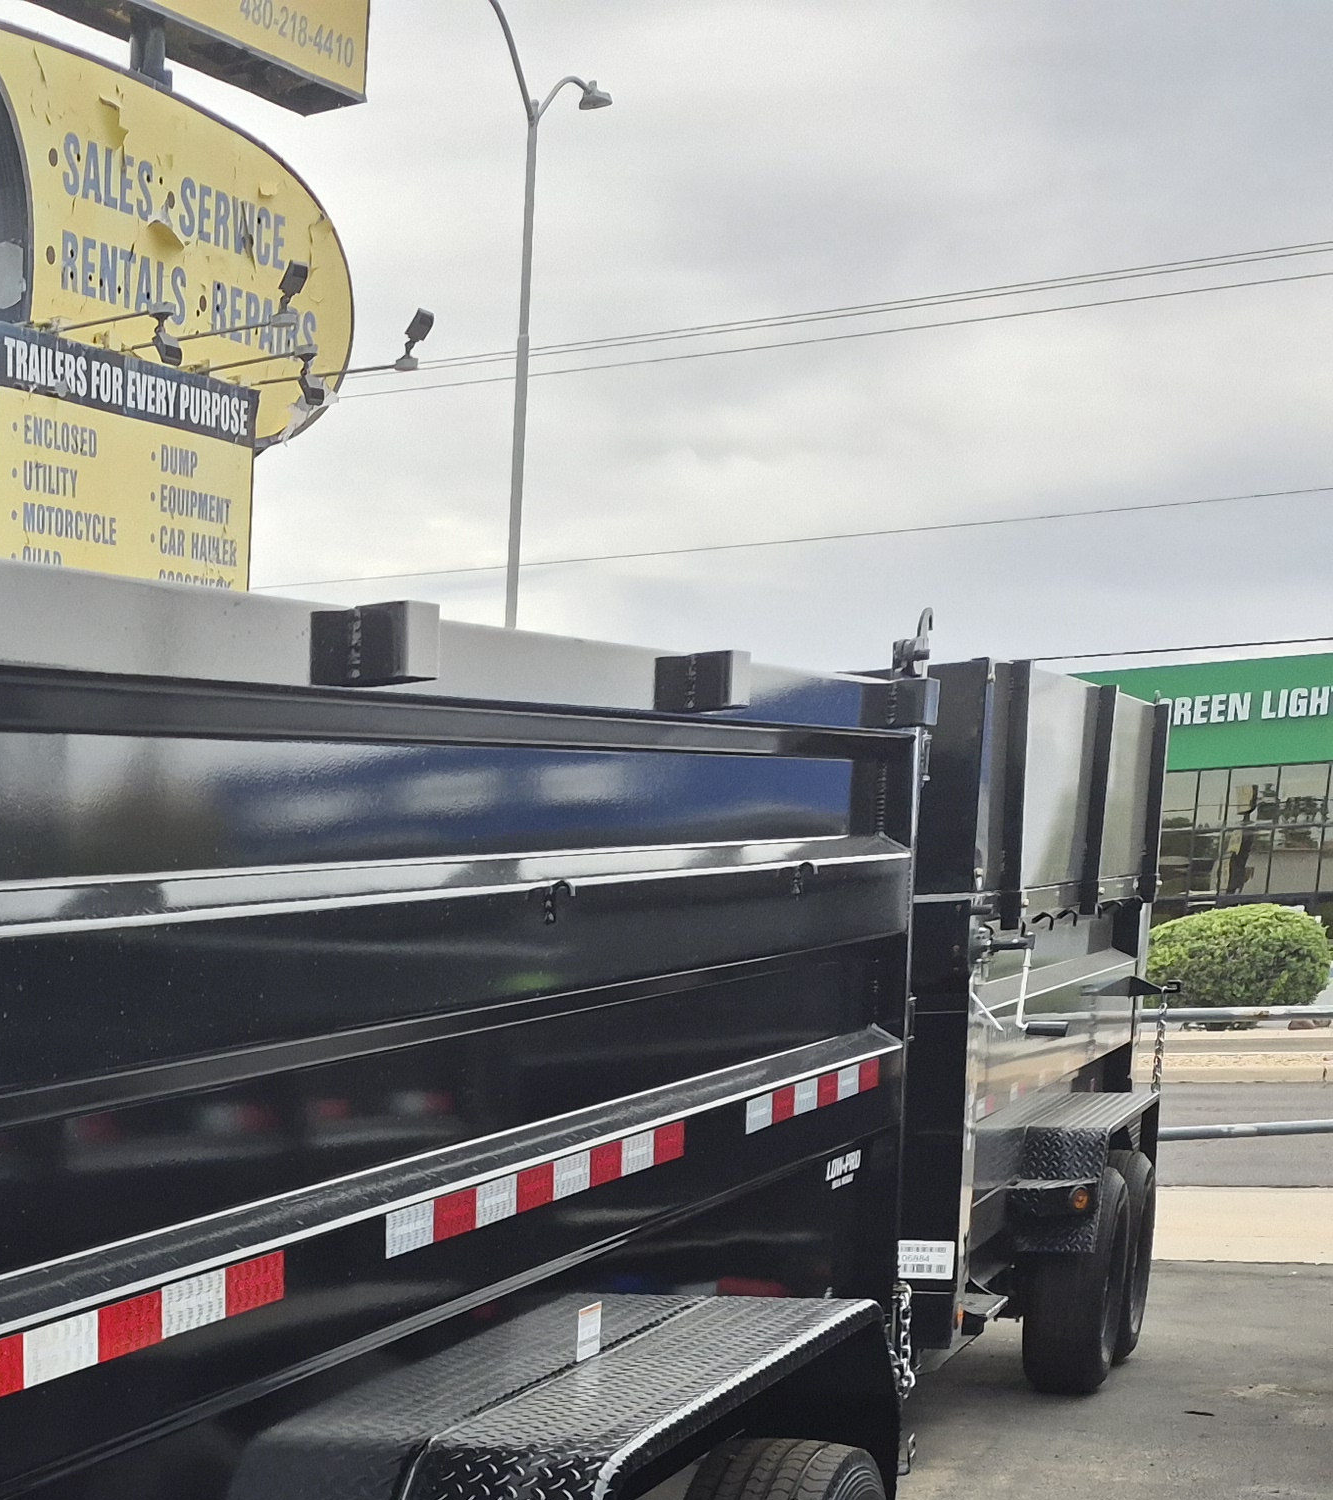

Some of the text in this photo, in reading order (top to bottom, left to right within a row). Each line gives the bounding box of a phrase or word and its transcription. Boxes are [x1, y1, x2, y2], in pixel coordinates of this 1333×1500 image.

[240, 0, 354, 68] 480-218-4410
[62, 132, 286, 270] SALES SERVICE
[61, 229, 317, 362] RENTALS REPAIRS
[4, 336, 248, 435] TRAILERS FOR EVERY PURPOSE
[24, 415, 98, 458] ENCLOSED
[23, 460, 78, 498] UTILITY
[161, 444, 198, 478] DUMP
[23, 502, 117, 546] MOTORCYCLE
[160, 484, 232, 526] EQUIPMENT
[160, 525, 238, 567] CAR HAULER
[1160, 686, 1333, 726] REEN LIGH
[825, 1149, 862, 1181] LOW-PRO
